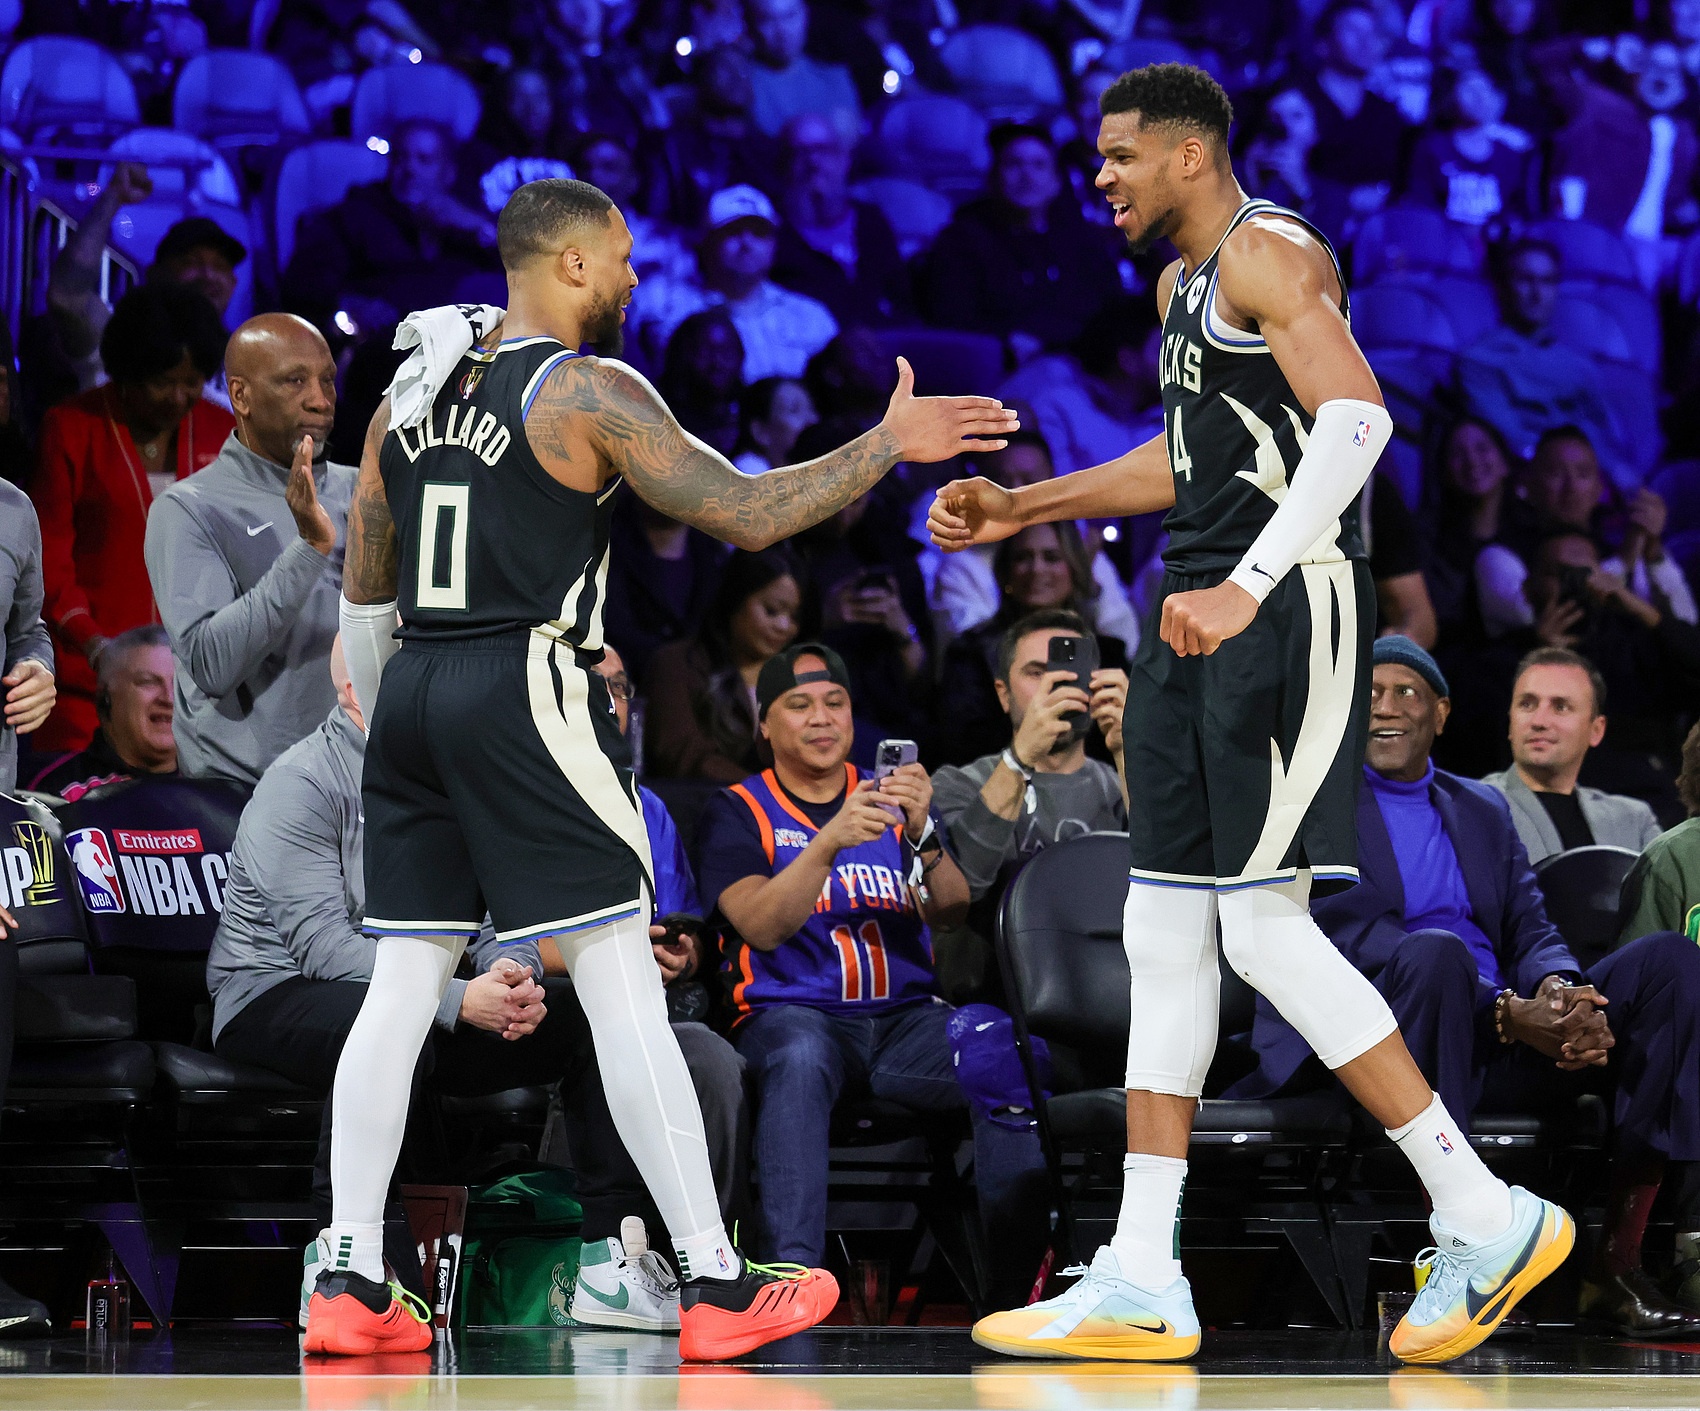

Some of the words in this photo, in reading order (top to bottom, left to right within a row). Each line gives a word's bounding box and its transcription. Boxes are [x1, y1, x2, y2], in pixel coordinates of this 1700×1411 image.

[1159, 333, 1202, 394] UCKS
[395, 404, 511, 467] LILLARD
[1164, 404, 1192, 482] 4
[415, 481, 471, 612] 0
[119, 832, 197, 849] Emirates
[89, 893, 112, 908] NBA
[118, 855, 206, 916] NBA
[201, 852, 233, 913] C
[829, 918, 889, 1002] 11
